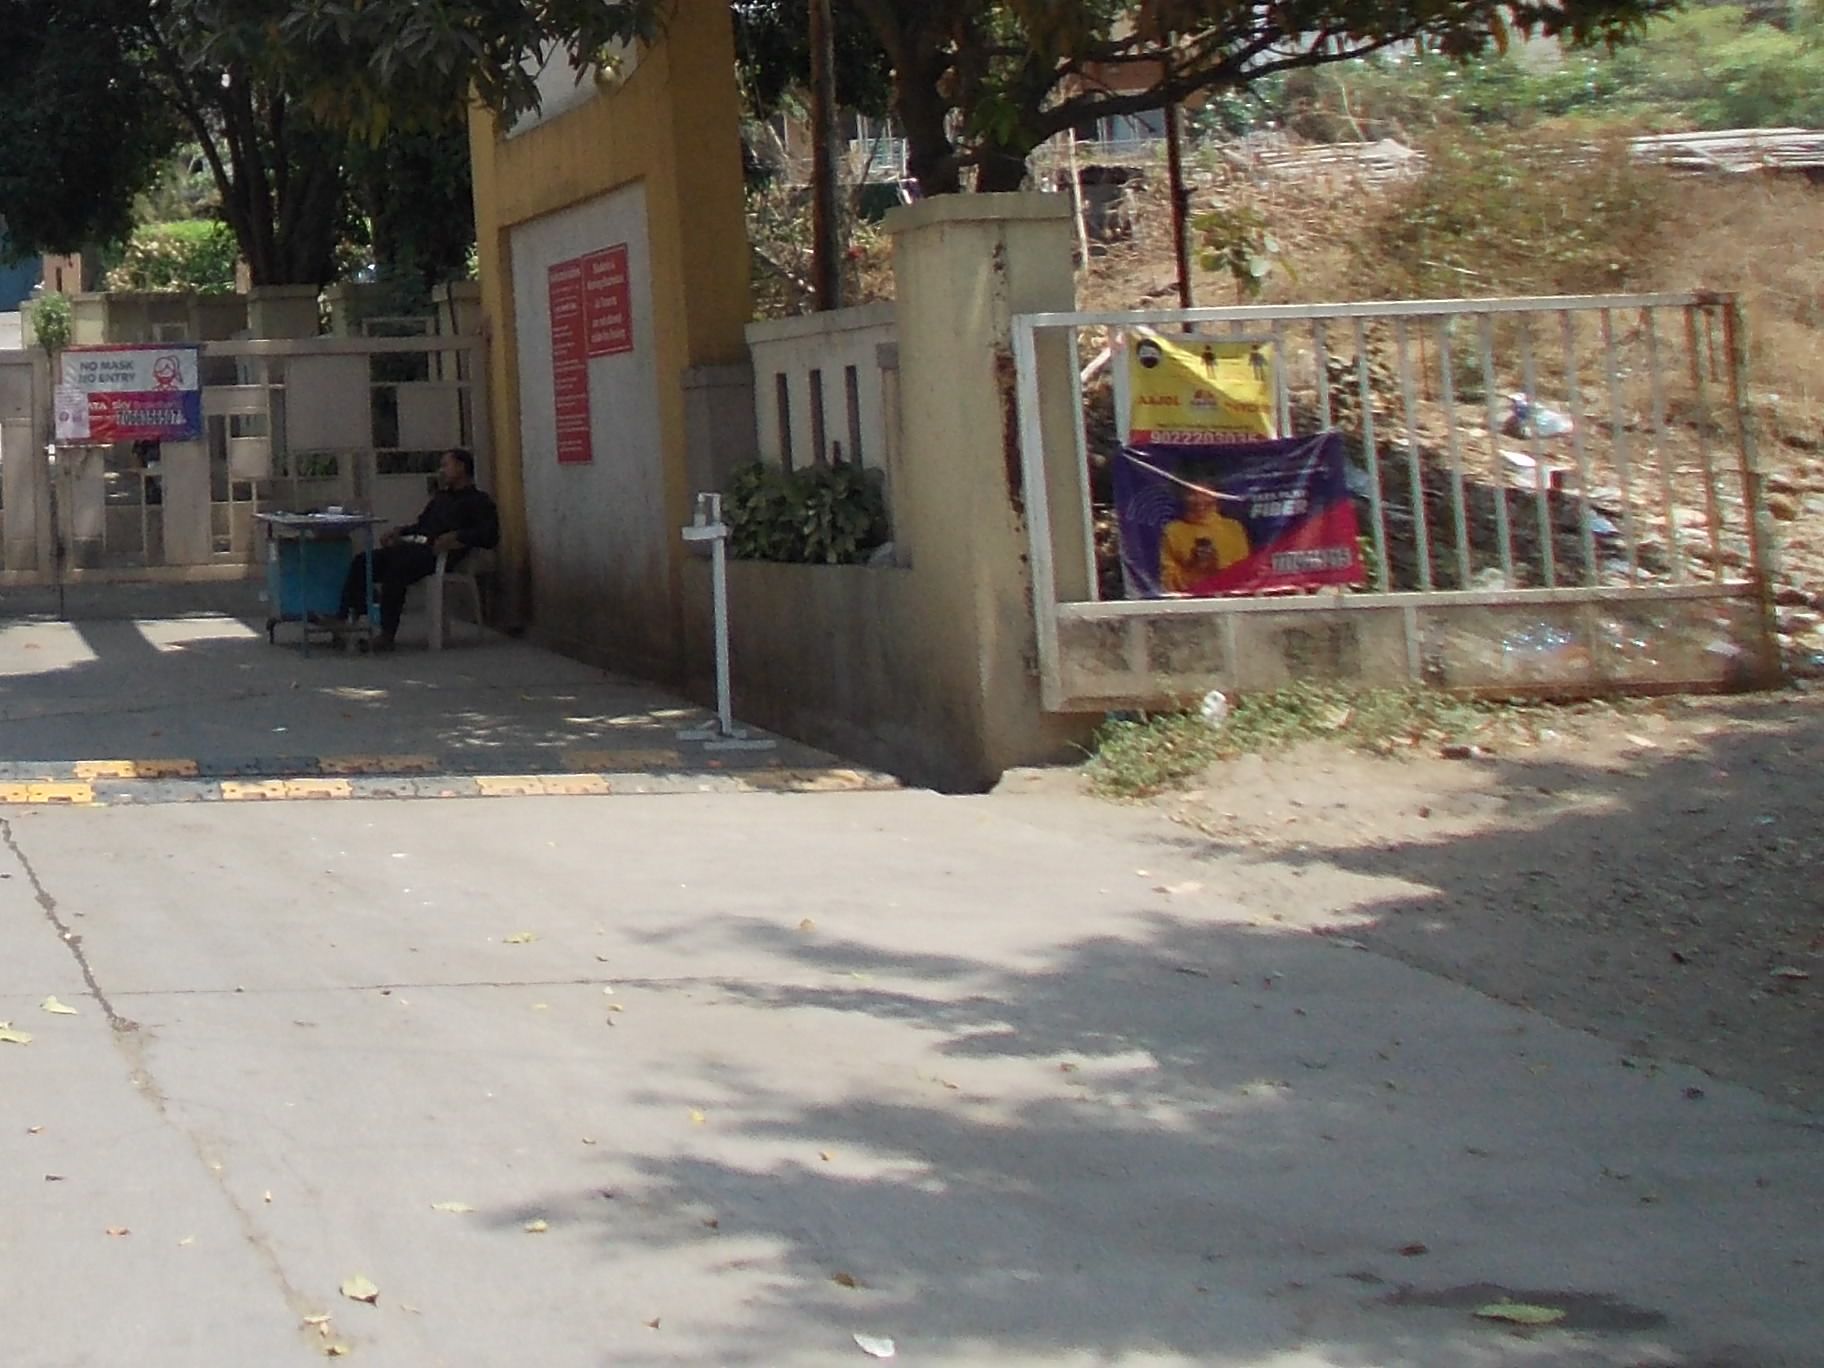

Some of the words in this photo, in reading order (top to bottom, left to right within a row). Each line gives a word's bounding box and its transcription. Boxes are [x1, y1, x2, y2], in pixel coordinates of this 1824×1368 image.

[80, 362, 98, 371] NO
[100, 361, 134, 370] MASK
[79, 373, 98, 383] NO
[99, 372, 136, 382] ENTRY
[88, 401, 108, 411] ATA
